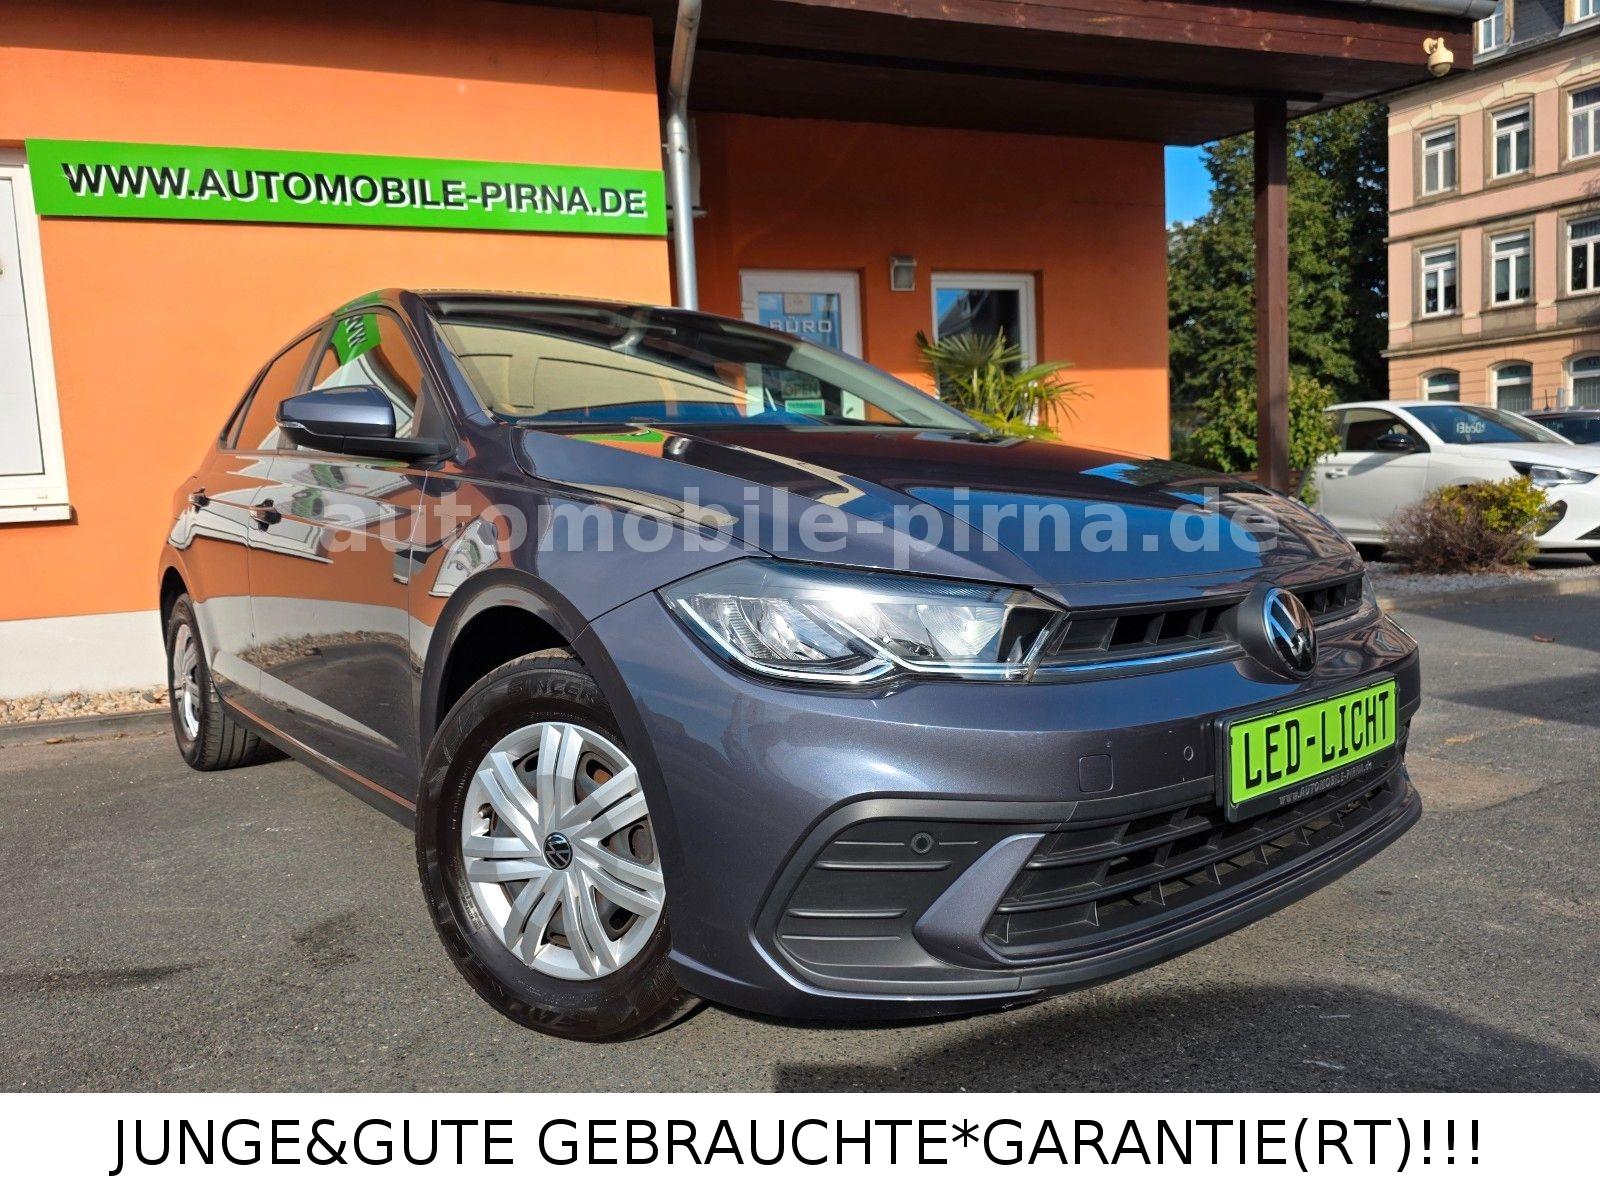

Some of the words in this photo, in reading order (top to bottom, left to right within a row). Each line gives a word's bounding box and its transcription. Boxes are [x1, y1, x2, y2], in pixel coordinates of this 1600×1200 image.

[61, 163, 648, 218] WWW.AUTOMOBILE-PIRNA.DE
[769, 316, 832, 333] BÜRO
[1244, 691, 1389, 790] LED-LICHT
